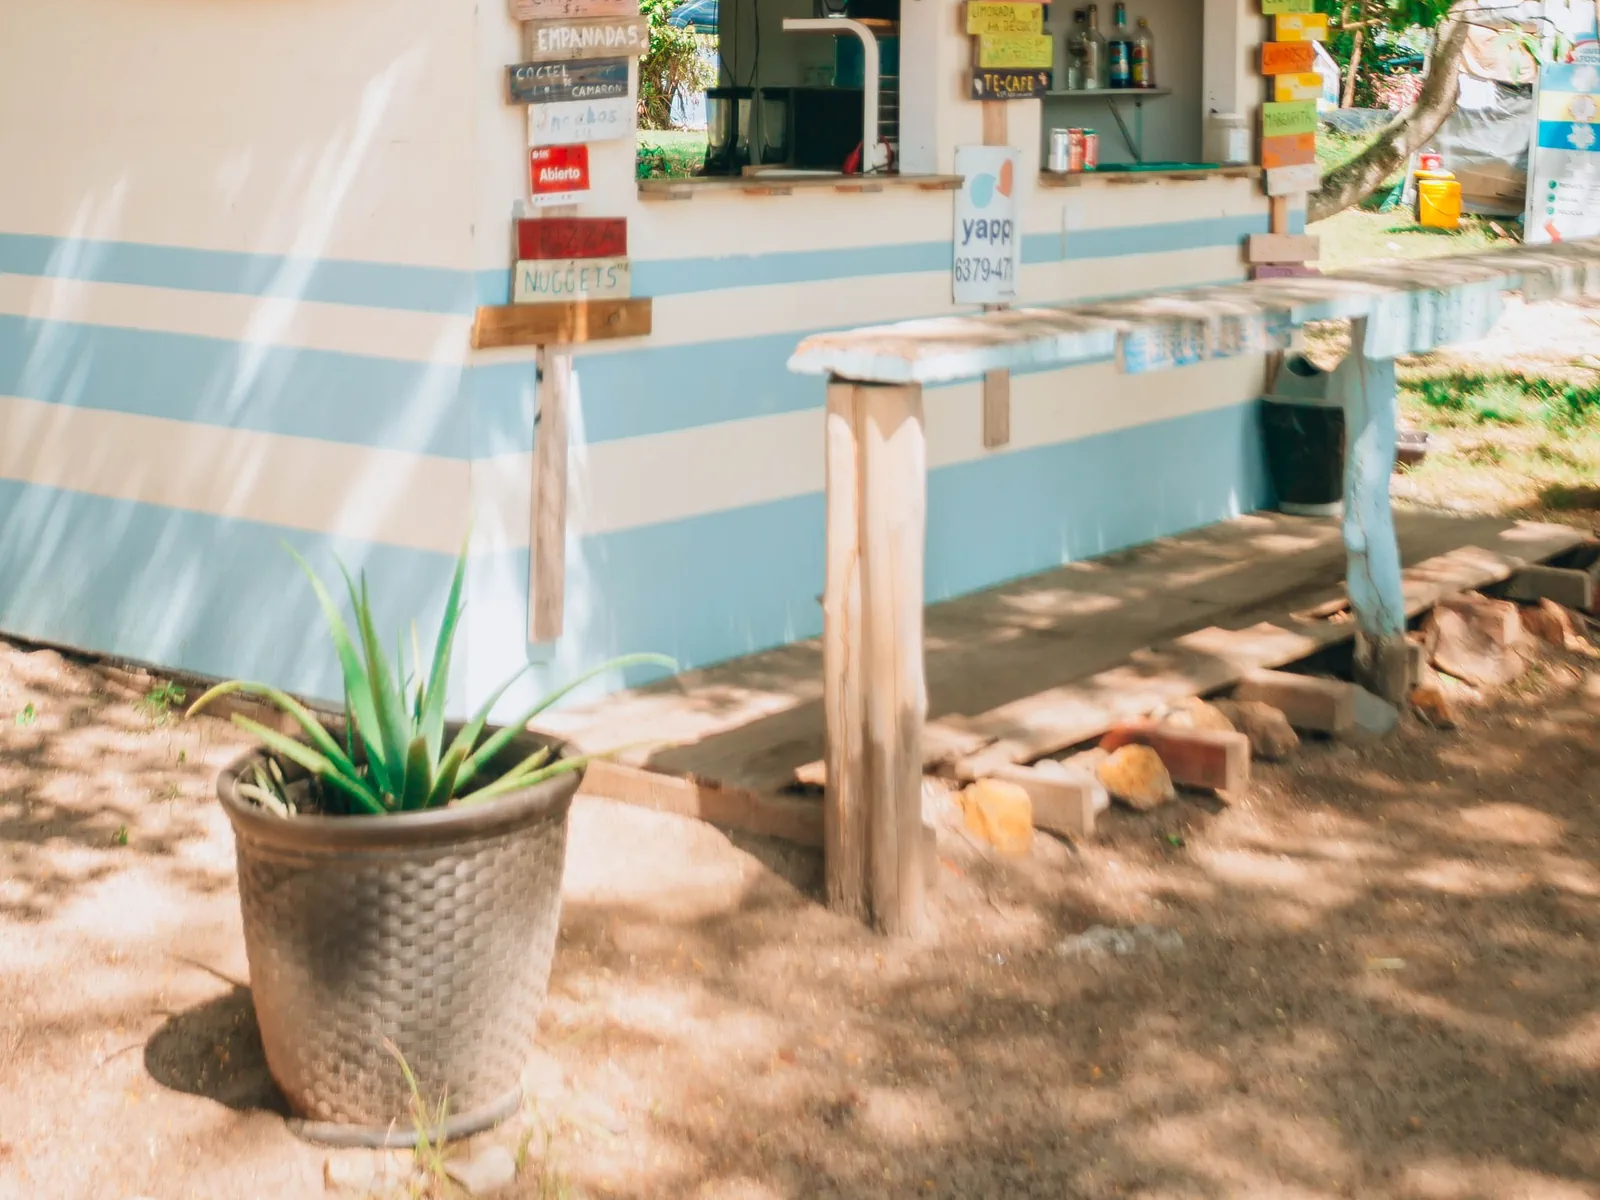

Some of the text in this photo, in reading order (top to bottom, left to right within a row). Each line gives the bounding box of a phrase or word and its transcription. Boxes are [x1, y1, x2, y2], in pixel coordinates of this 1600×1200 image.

[537, 25, 639, 51] EMPANADAS
[515, 63, 569, 81] COCTEL
[571, 84, 622, 98] CAMARON
[539, 165, 581, 183] Abierto
[961, 217, 1014, 246] yapp
[524, 265, 617, 294] NUGGETS
